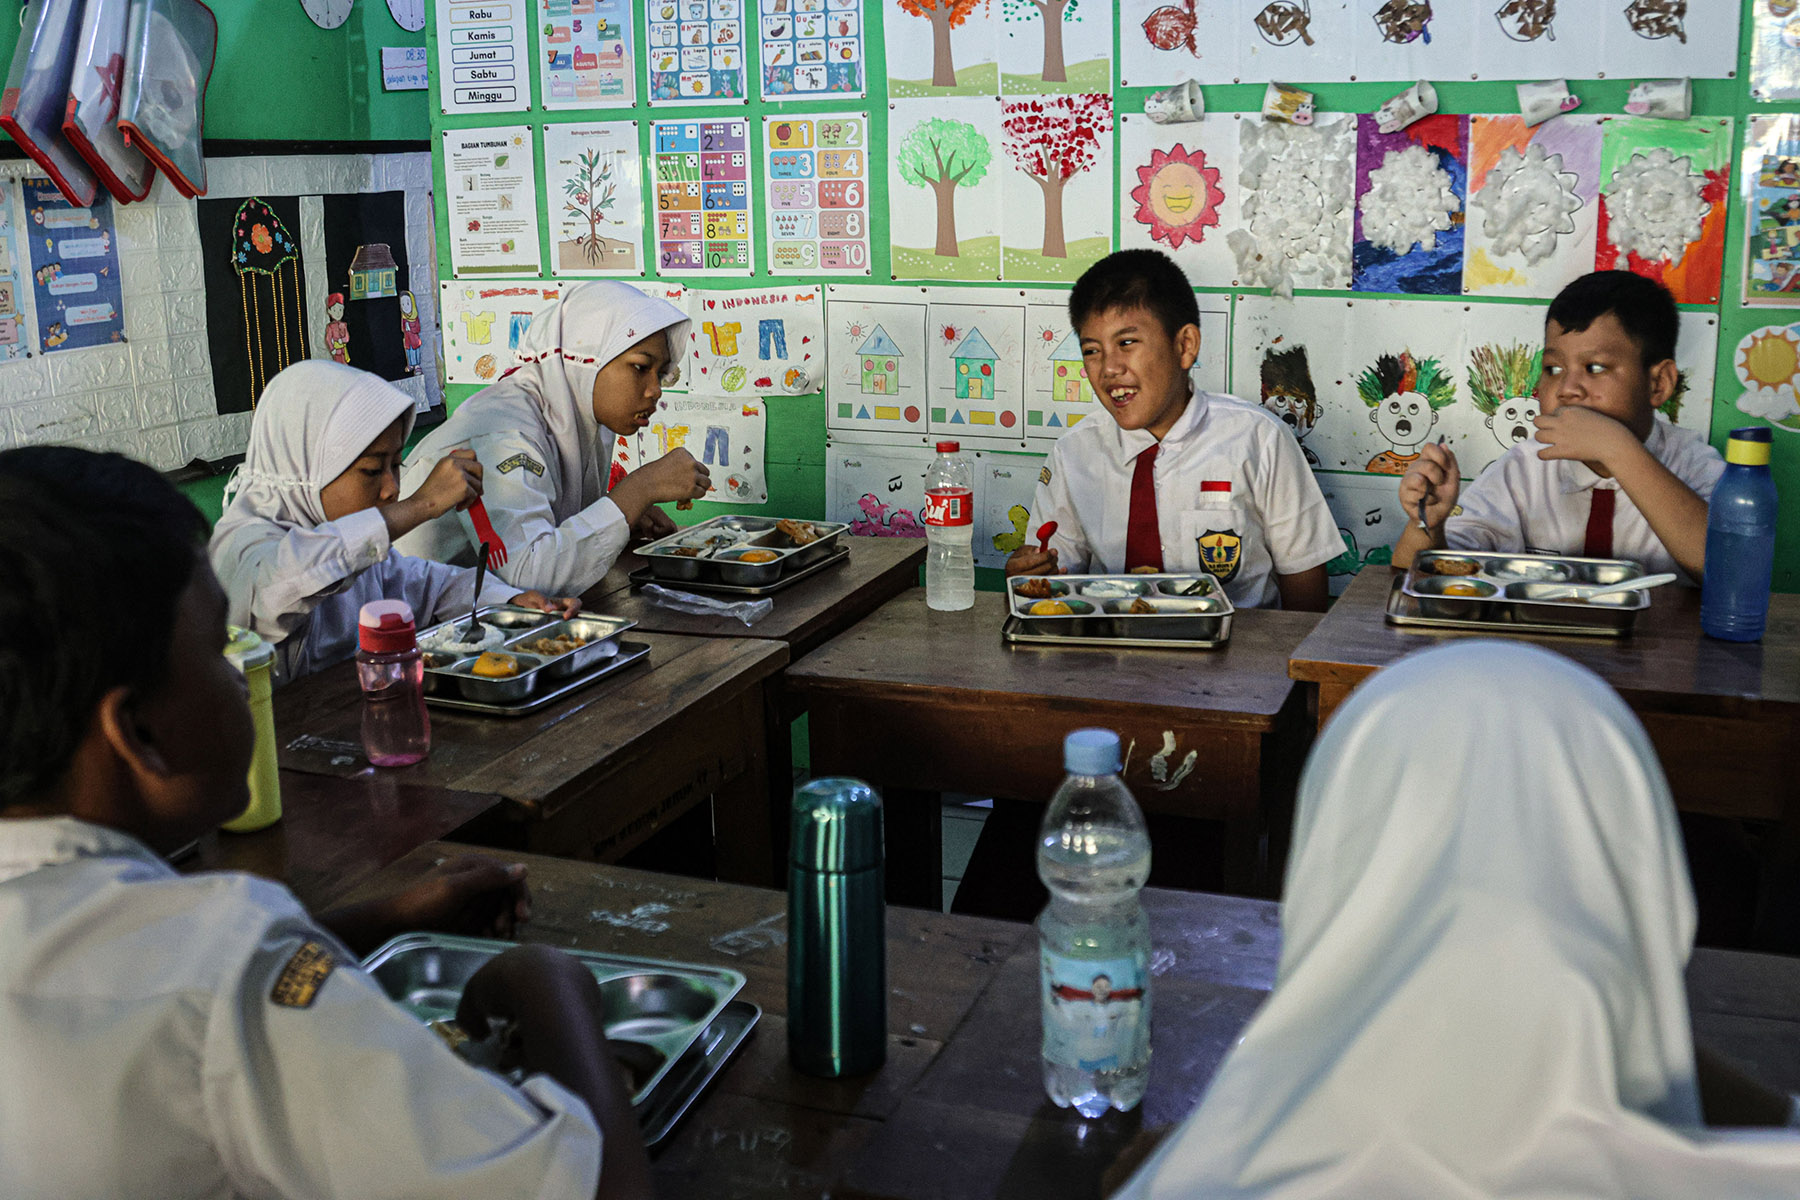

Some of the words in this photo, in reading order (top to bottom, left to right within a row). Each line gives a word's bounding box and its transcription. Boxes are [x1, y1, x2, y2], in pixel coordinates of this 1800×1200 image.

[470, 9, 492, 19] Rabu
[544, 24, 554, 36] 4
[573, 20, 582, 32] 5
[598, 18, 608, 31] 6
[468, 31, 496, 40] Kamis
[470, 51, 496, 60] Jumat
[547, 50, 558, 64] 7
[615, 44, 623, 58] 9
[470, 70, 497, 79] Sabtu
[468, 91, 502, 102] Minggu
[798, 122, 808, 146] 1
[846, 121, 858, 145] 2
[661, 136, 664, 152] 1
[704, 135, 713, 150] 2
[799, 153, 812, 176] 3
[843, 152, 859, 175] 4
[659, 166, 668, 180] 3
[704, 164, 714, 180] 4
[705, 194, 715, 210] 6
[800, 183, 812, 206] 5
[845, 183, 860, 206] 6
[660, 195, 669, 210] 5
[662, 223, 669, 238] 7
[707, 224, 716, 238] 8
[800, 213, 813, 236] 7
[846, 213, 860, 236] 8
[663, 252, 672, 266] 9
[707, 253, 721, 268] 10
[801, 244, 814, 266] 9
[841, 244, 864, 265] 10
[702, 299, 706, 311] I
[722, 294, 788, 310] INDONESIA
